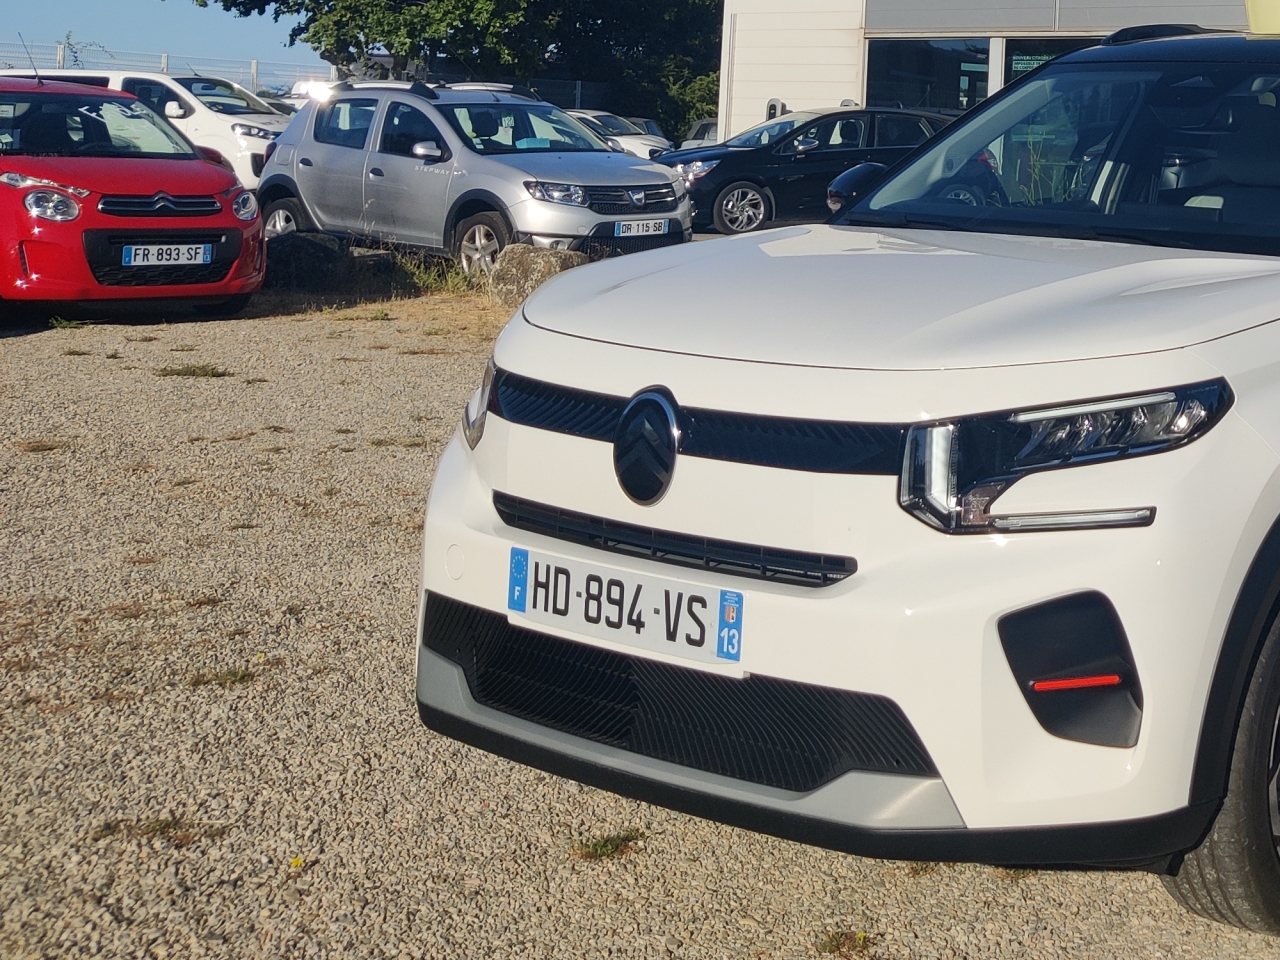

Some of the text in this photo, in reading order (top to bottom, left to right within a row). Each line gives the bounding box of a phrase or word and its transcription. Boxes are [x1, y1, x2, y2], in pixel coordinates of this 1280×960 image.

[414, 165, 451, 176] STEPWAY
[133, 246, 202, 262] FR-893-SF
[514, 586, 522, 601] F
[532, 561, 708, 647] HD-894-VS
[720, 627, 739, 654] 13
